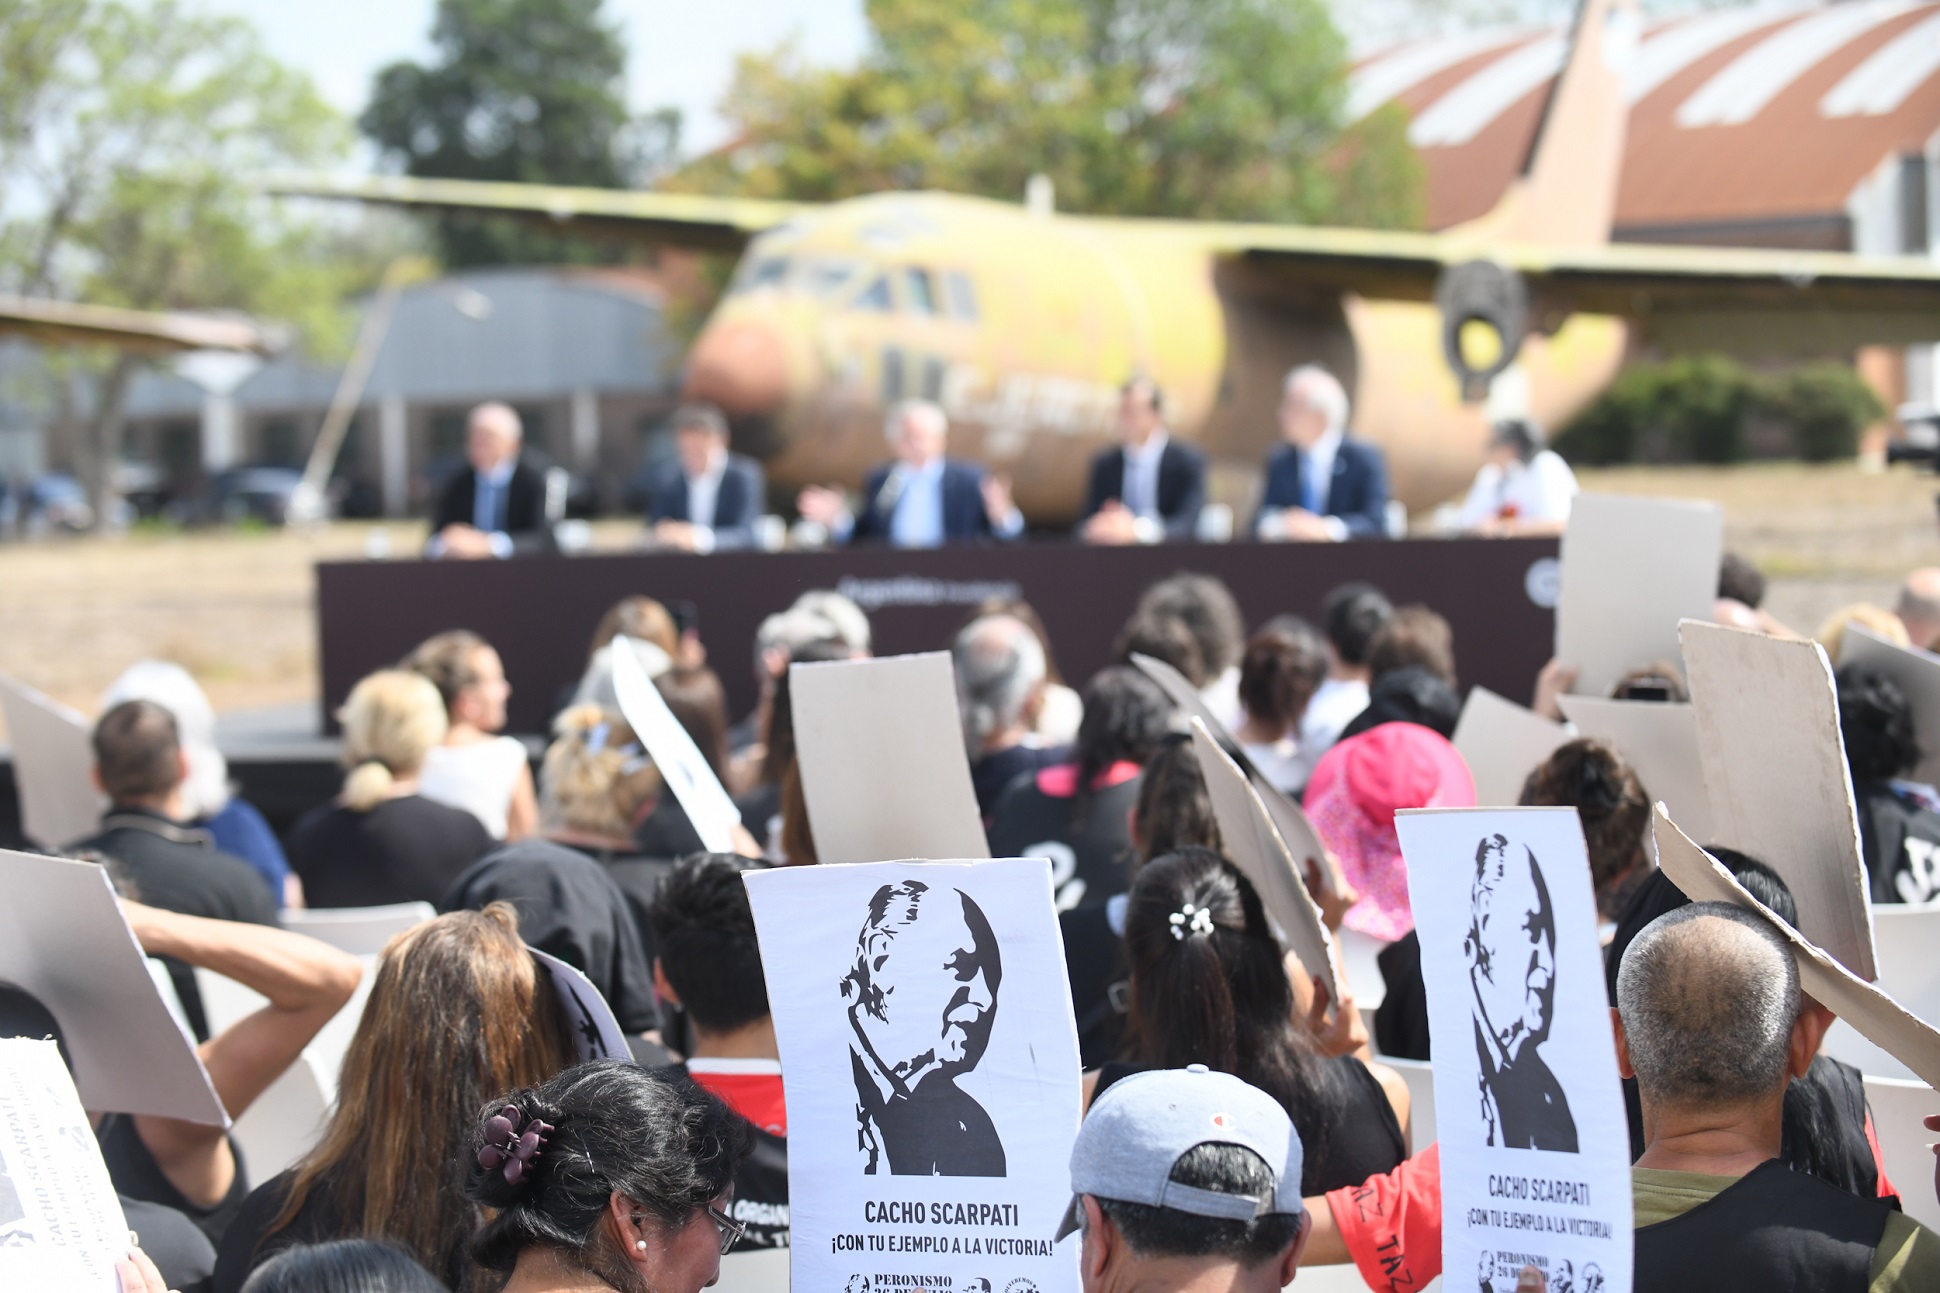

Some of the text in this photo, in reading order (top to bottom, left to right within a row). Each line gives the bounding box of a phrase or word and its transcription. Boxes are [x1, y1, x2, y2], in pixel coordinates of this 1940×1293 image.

[1489, 1175, 1590, 1206] CACHO SCARPATI
[35, 1187, 66, 1247] CACHO
[865, 1201, 1019, 1227] CACHO SCARPATI
[1467, 1208, 1488, 1228] ¡CON
[1490, 1210, 1501, 1228] TU
[1504, 1212, 1544, 1232] EJEMPLO
[1547, 1217, 1553, 1232] A
[1556, 1218, 1567, 1234] LA
[832, 1234, 1053, 1257] ¡CON TU EJEMPLO A LA VICTORIA!
[1497, 1251, 1549, 1267] PERONISMO
[874, 1274, 953, 1287] PERONISMO
